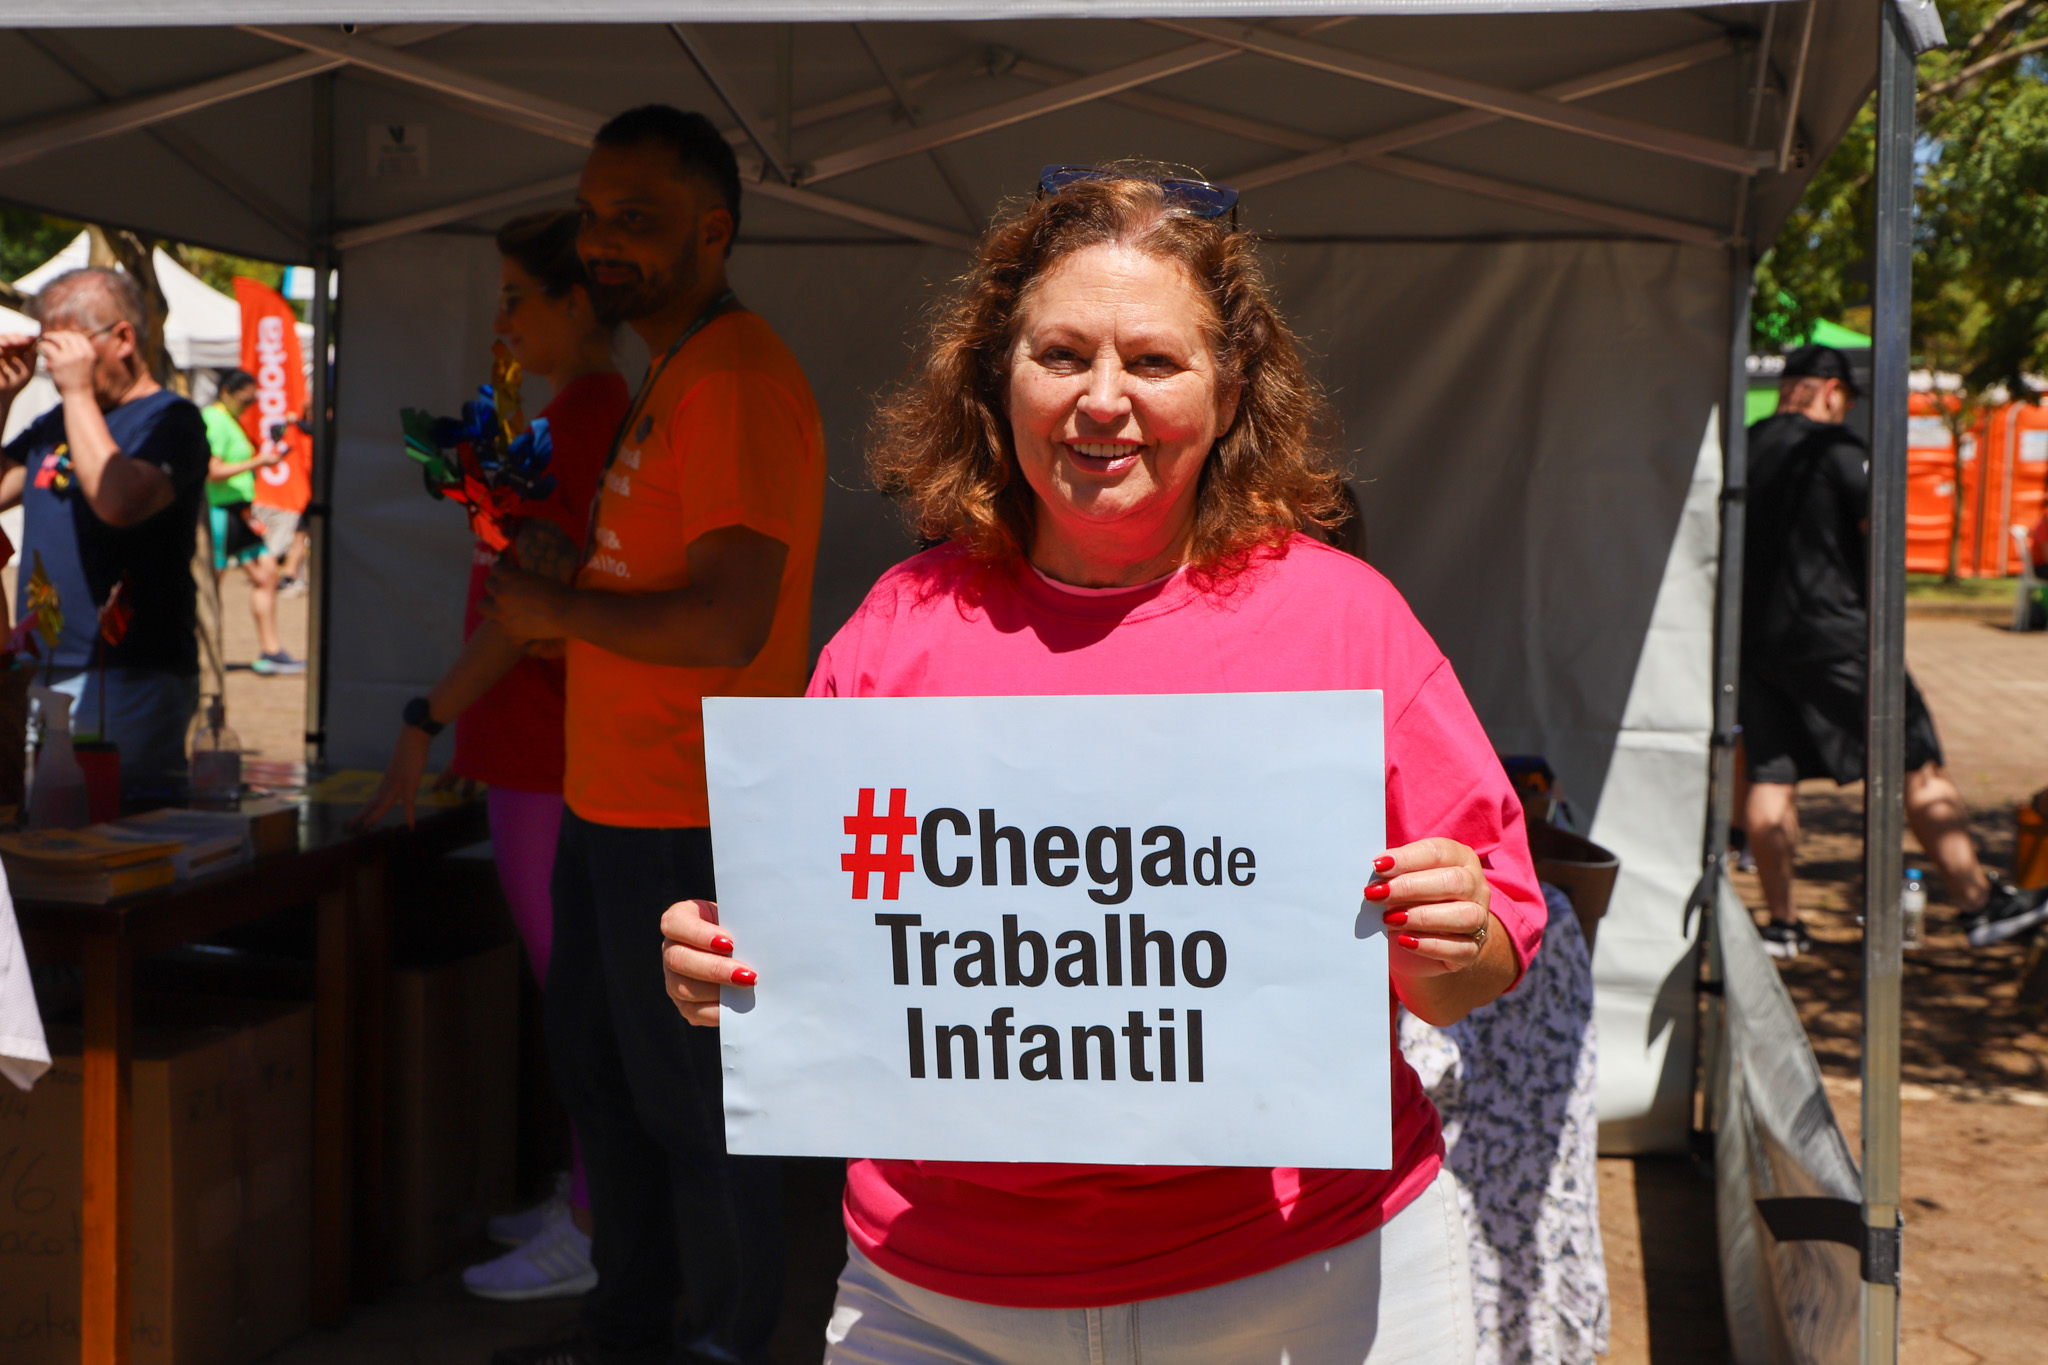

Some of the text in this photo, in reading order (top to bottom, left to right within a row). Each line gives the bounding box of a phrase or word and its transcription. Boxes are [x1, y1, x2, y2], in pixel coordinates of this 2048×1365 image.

[841, 788, 1255, 905] #Chega de
[875, 913, 1226, 988] Trabalho
[907, 1007, 1203, 1082] Infantil
